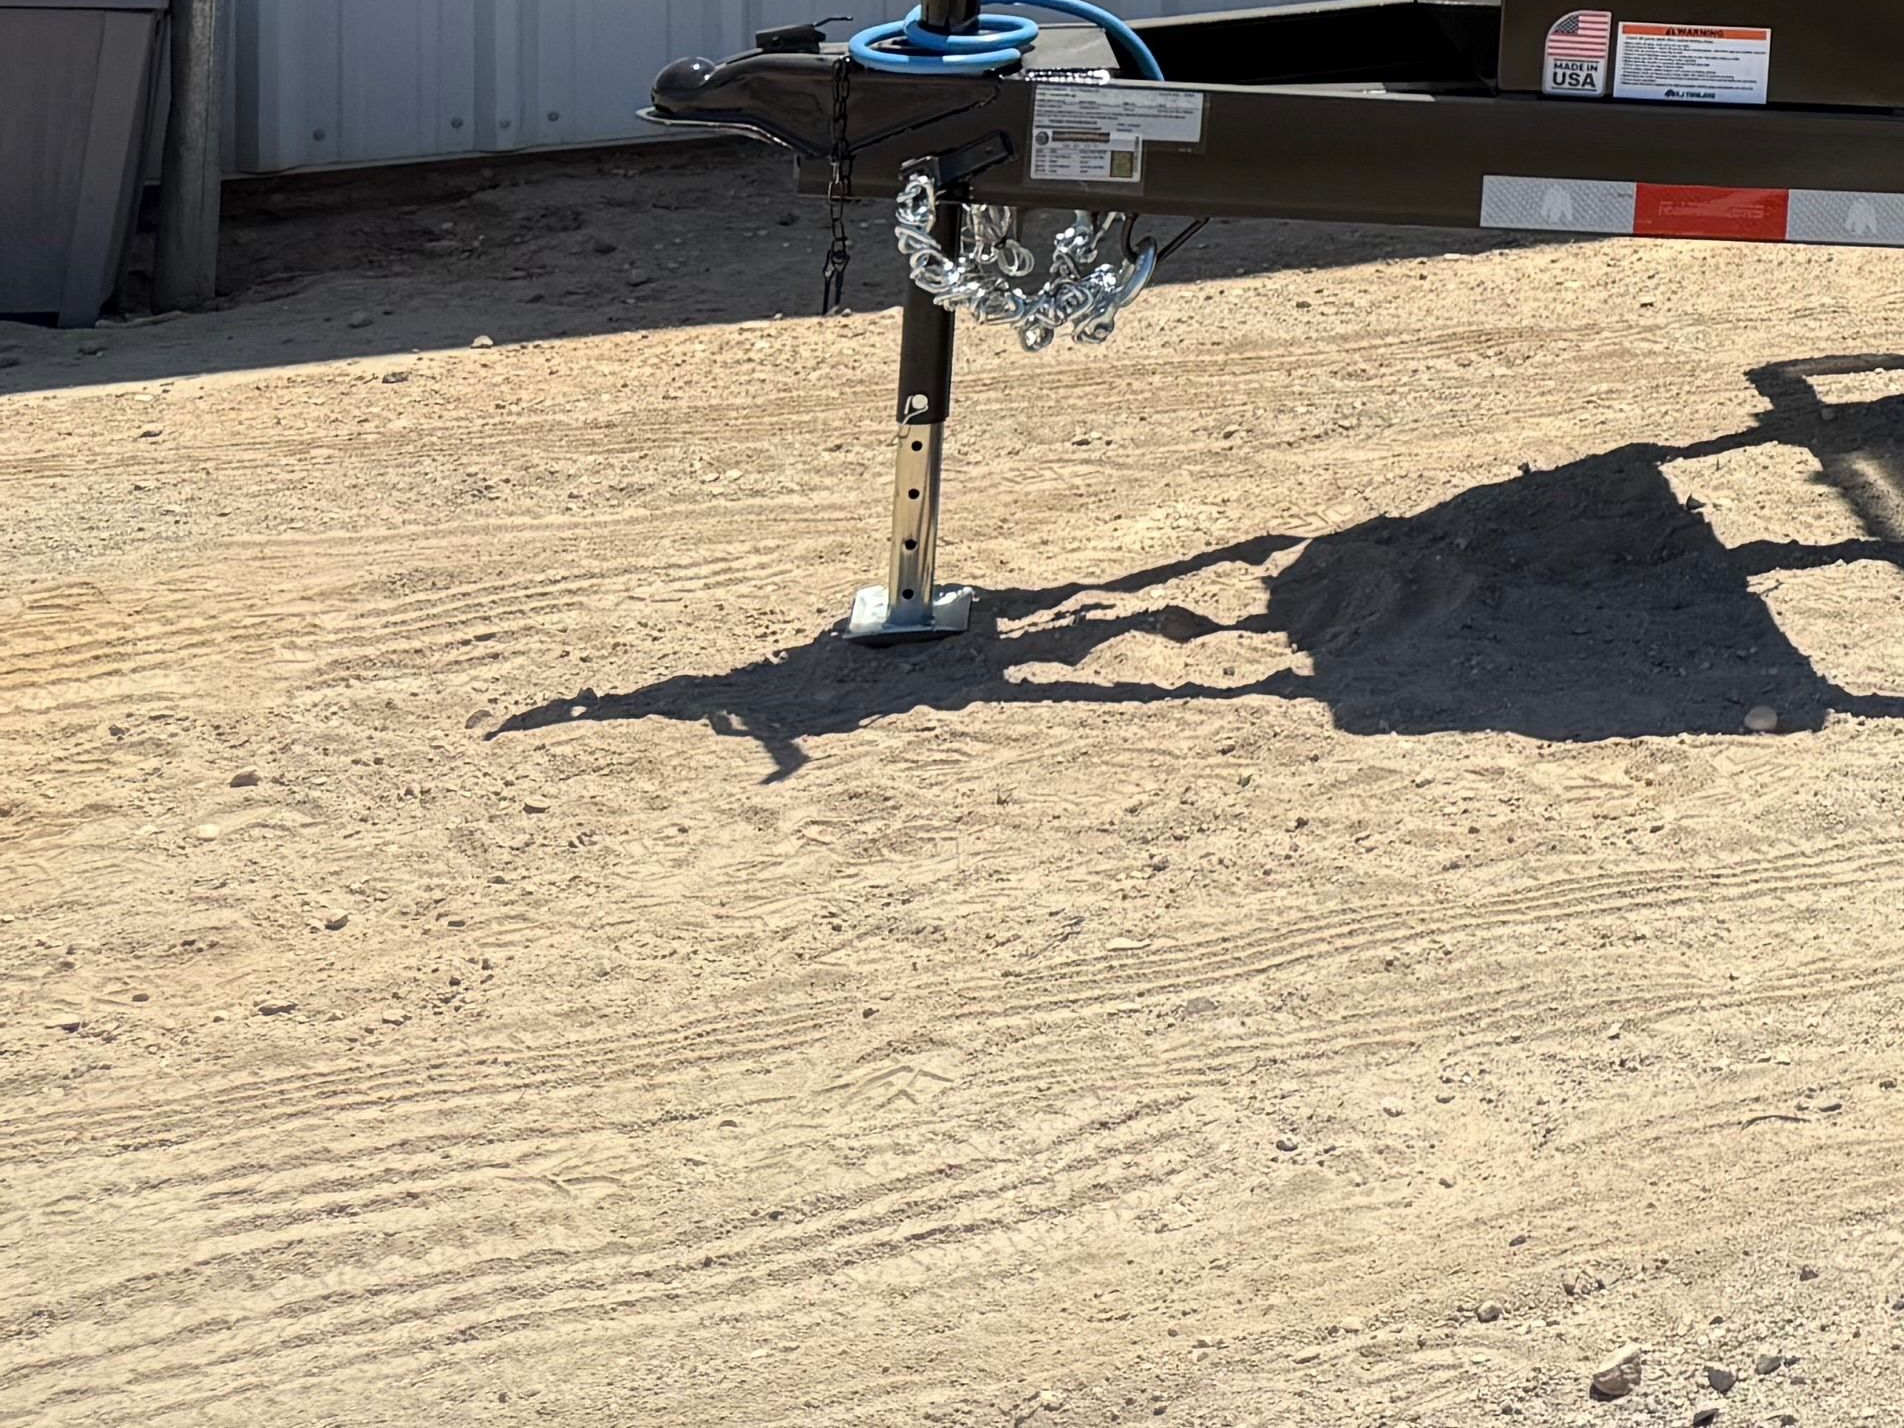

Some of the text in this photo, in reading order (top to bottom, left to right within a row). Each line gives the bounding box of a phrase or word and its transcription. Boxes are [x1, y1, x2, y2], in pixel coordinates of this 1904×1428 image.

[1553, 62, 1598, 72] MADE IN
[1552, 71, 1597, 88] USA
